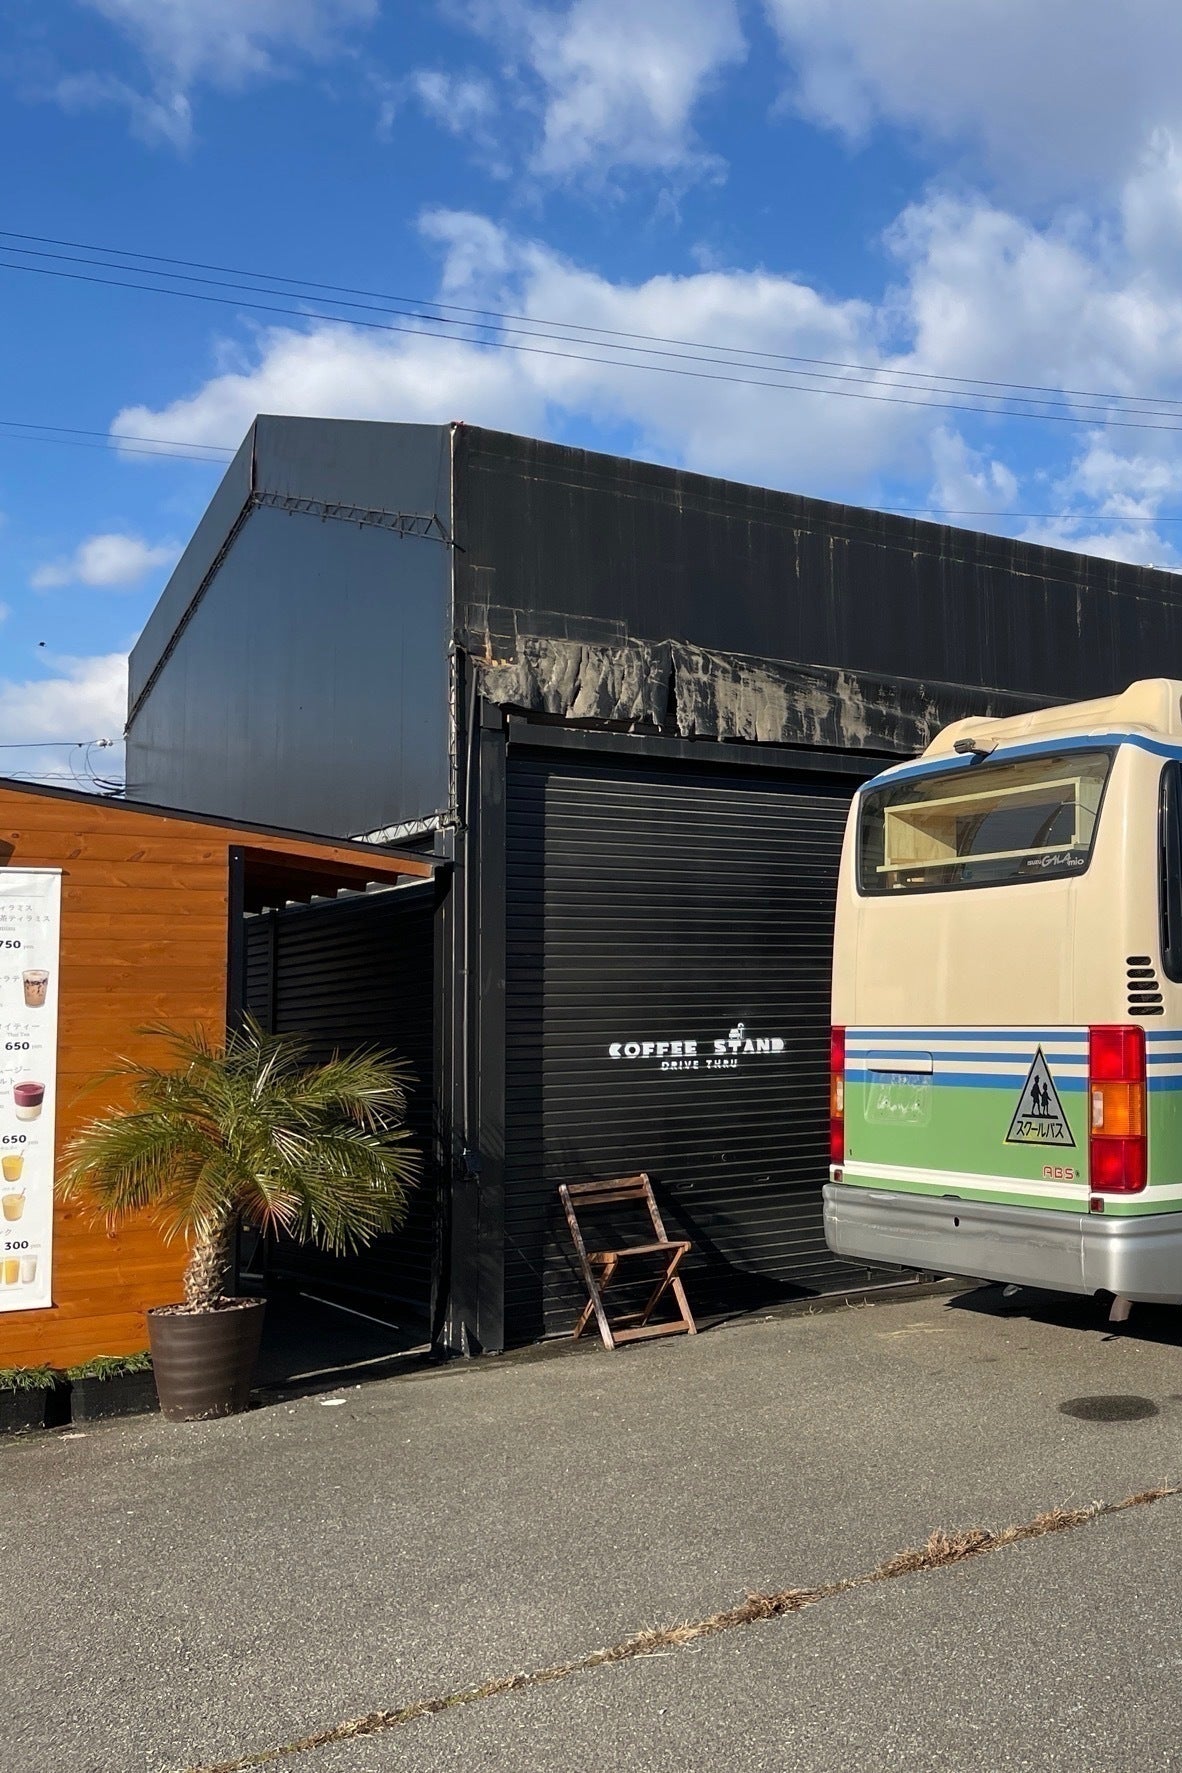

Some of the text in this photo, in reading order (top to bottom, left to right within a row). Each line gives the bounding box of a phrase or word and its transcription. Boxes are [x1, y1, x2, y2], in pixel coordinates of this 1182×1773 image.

[0, 940, 21, 949] 750
[5, 1041, 30, 1051] 650
[608, 1037, 785, 1059] COFFEE STAND
[660, 1058, 738, 1071] DRIVE THRU
[1016, 1120, 1064, 1139] スクールバス
[2, 1134, 27, 1144] 650
[1043, 1166, 1074, 1180] ABS
[4, 1240, 29, 1251] 300
